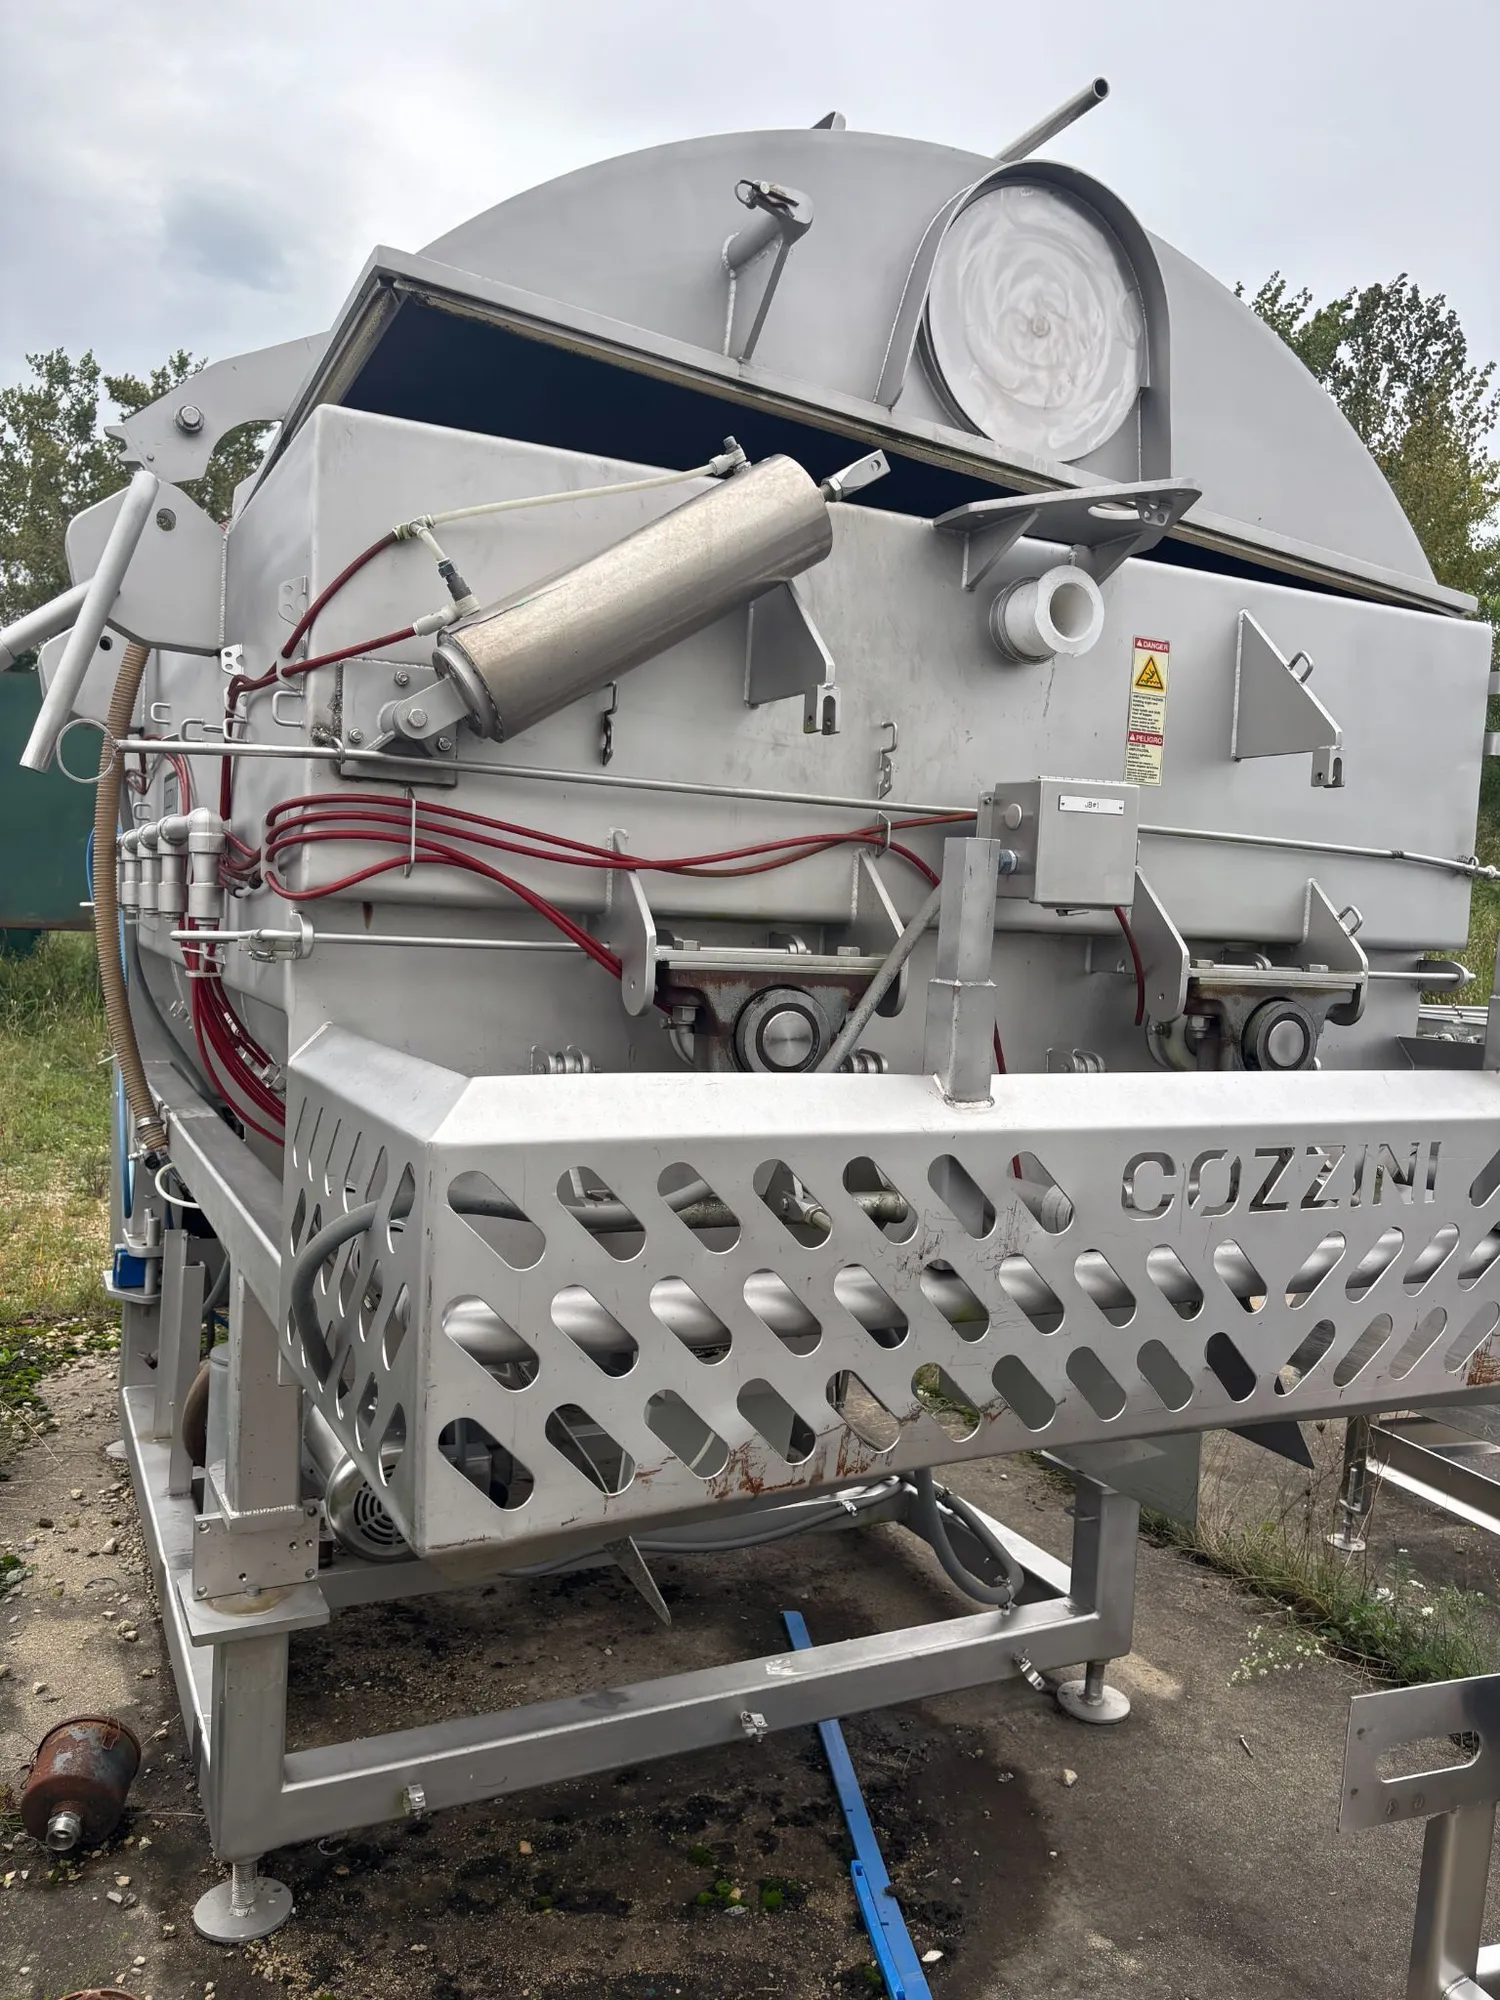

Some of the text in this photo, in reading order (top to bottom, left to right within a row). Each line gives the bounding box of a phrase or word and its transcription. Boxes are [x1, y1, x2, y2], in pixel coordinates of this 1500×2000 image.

[1143, 640, 1168, 652] DANGER
[1136, 734, 1162, 744] PELIGRO
[1120, 1141, 1442, 1222] COZZINI
